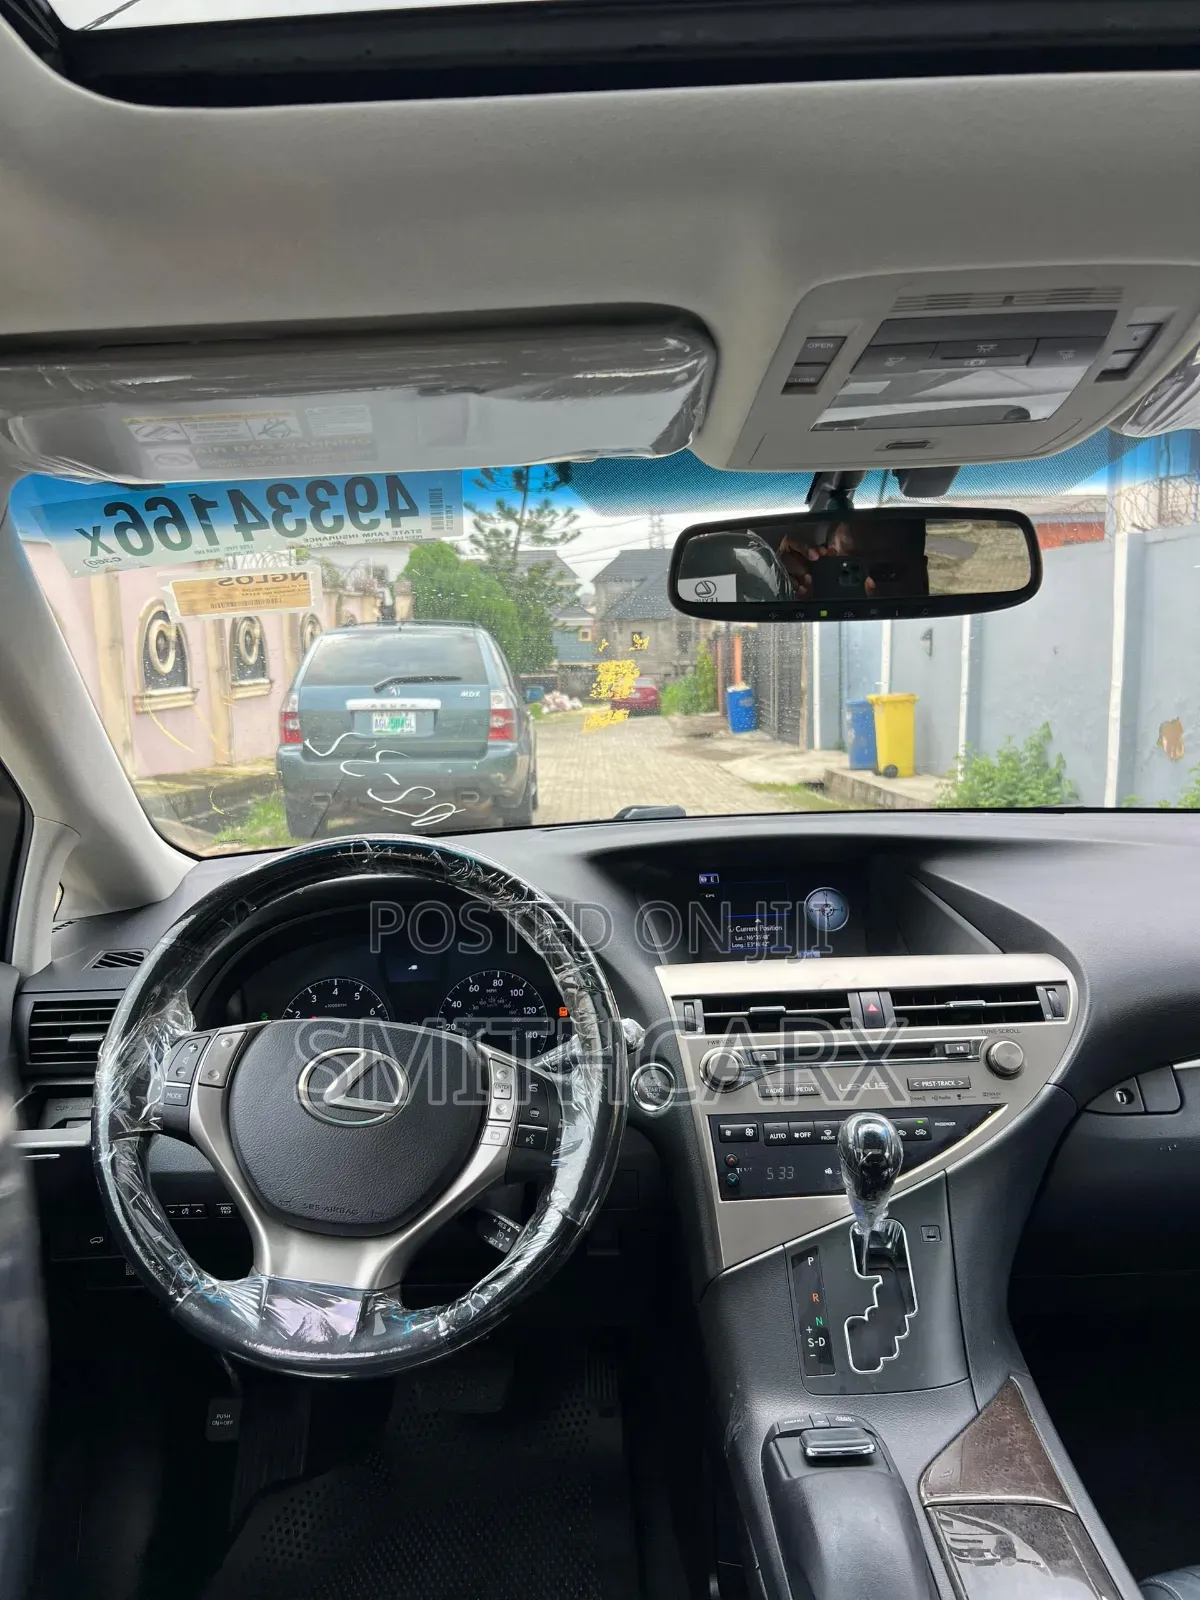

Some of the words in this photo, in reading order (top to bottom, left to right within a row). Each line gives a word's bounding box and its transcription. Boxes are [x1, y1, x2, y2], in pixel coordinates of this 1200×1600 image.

[460, 690, 480, 698] MDX
[735, 924, 758, 933] Current
[760, 924, 783, 932] Position
[492, 978, 503, 987] 80
[332, 987, 339, 996] 4
[469, 984, 480, 992] 60
[510, 988, 524, 997] 100
[354, 992, 360, 1001] 5
[451, 1000, 462, 1008] 40
[295, 1010, 301, 1019] 2
[523, 1006, 537, 1014] 120
[446, 1023, 457, 1031] 20
[524, 1031, 538, 1039] 140
[838, 1081, 889, 1091] LEXUS
[769, 1132, 787, 1140] AUTO
[799, 1131, 812, 1139] OFF
[807, 1256, 814, 1266] P
[812, 1292, 820, 1302] R
[815, 1316, 823, 1326] N
